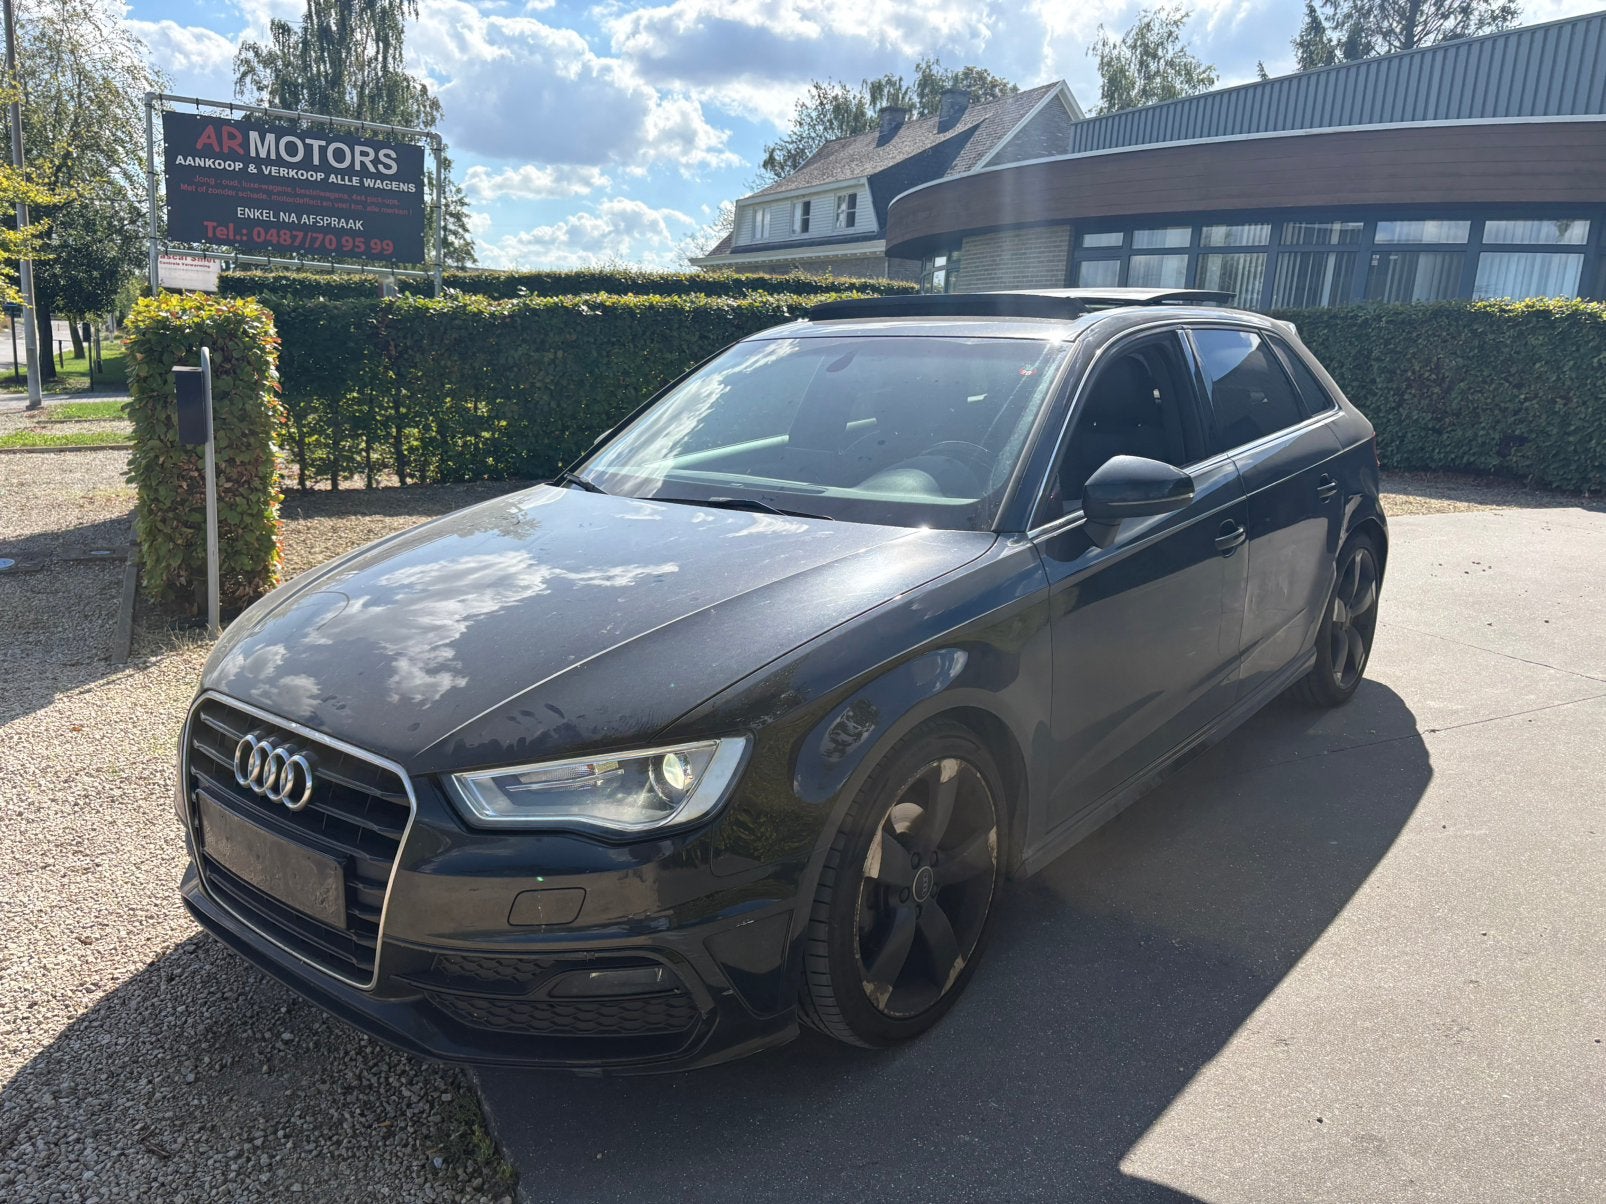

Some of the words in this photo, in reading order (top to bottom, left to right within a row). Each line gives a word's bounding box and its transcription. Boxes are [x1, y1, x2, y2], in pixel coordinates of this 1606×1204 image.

[195, 123, 245, 156] AR
[248, 130, 398, 175] MOTORS
[175, 155, 244, 172] AANKOOP
[247, 163, 258, 174] &
[261, 165, 325, 182] VERKOOP
[328, 173, 361, 187] ALLE
[363, 177, 417, 193] WAGENS
[194, 175, 216, 186] Jong
[180, 183, 196, 192] Met
[207, 187, 237, 197] zonder
[237, 206, 278, 221] ENKEL
[279, 211, 299, 224] NA
[300, 214, 365, 231] AFSPRAAK
[203, 220, 249, 241] Tel.:
[252, 226, 337, 250] 0487/70
[341, 235, 366, 253] 95
[370, 238, 395, 255] 99
